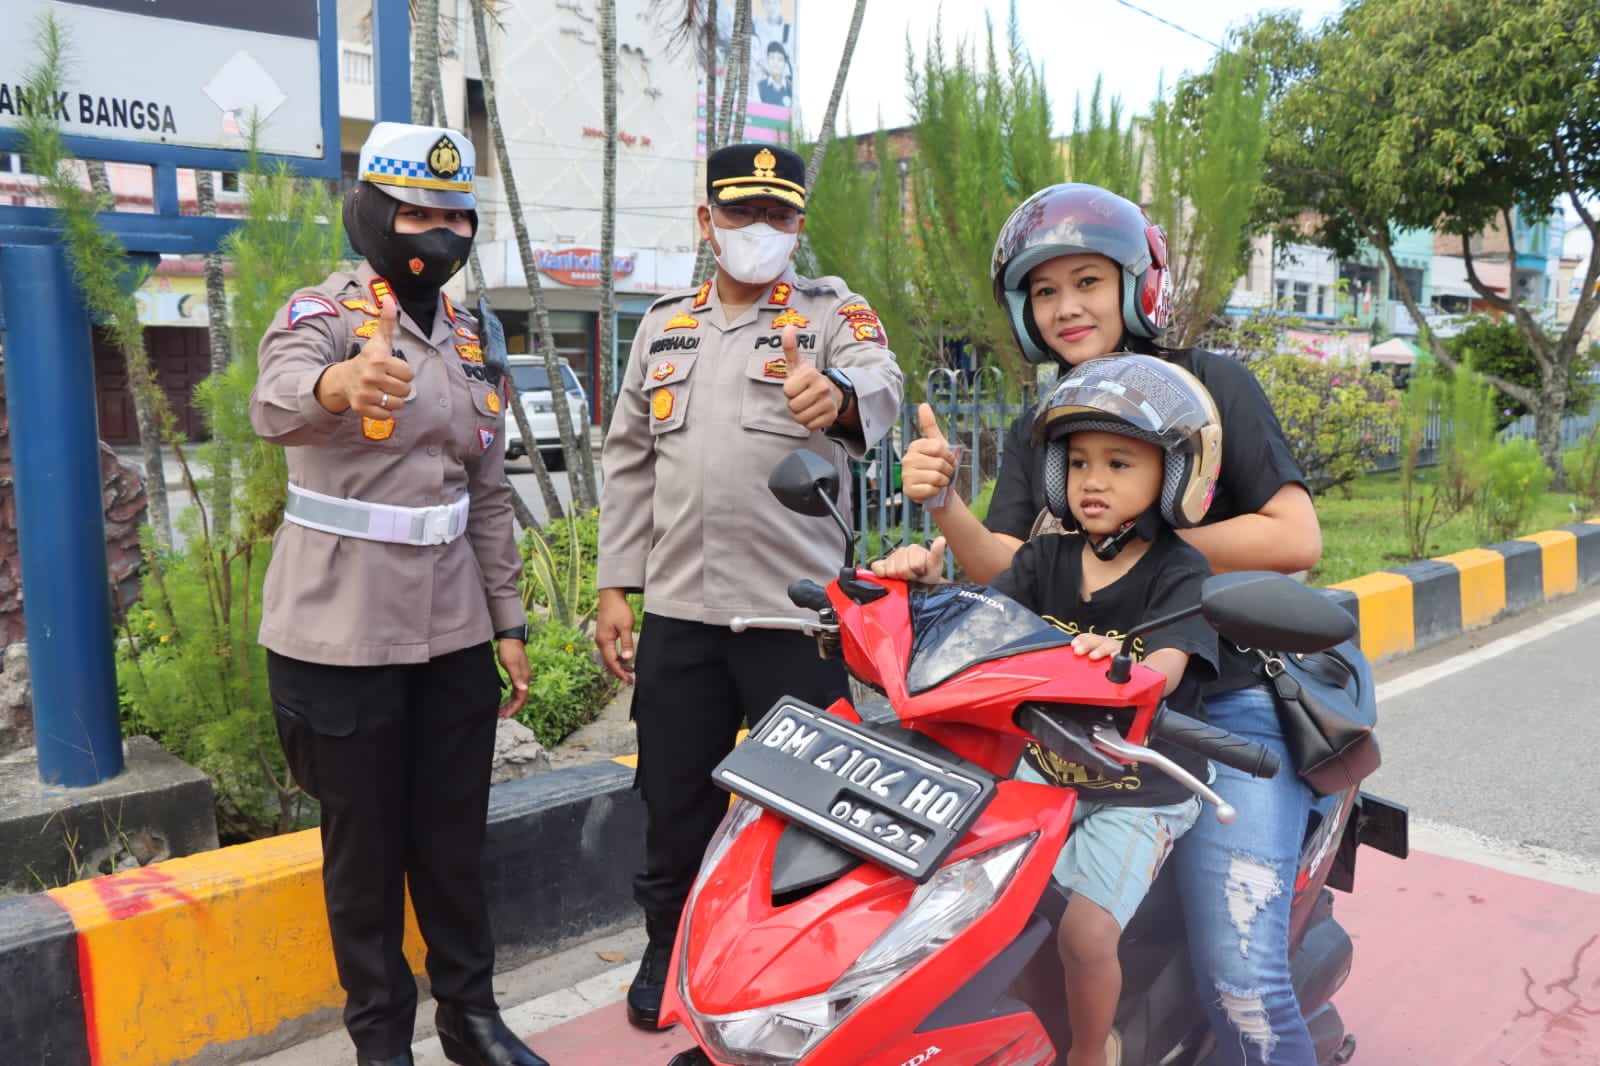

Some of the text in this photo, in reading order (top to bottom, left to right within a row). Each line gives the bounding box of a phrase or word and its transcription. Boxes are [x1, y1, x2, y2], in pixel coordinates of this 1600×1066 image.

[78, 92, 177, 134] BANGSA
[534, 249, 635, 274] Vanhollno
[754, 334, 816, 349] PORI
[959, 590, 1004, 612] HONDA
[763, 717, 818, 757] BM
[813, 745, 904, 797] 4104
